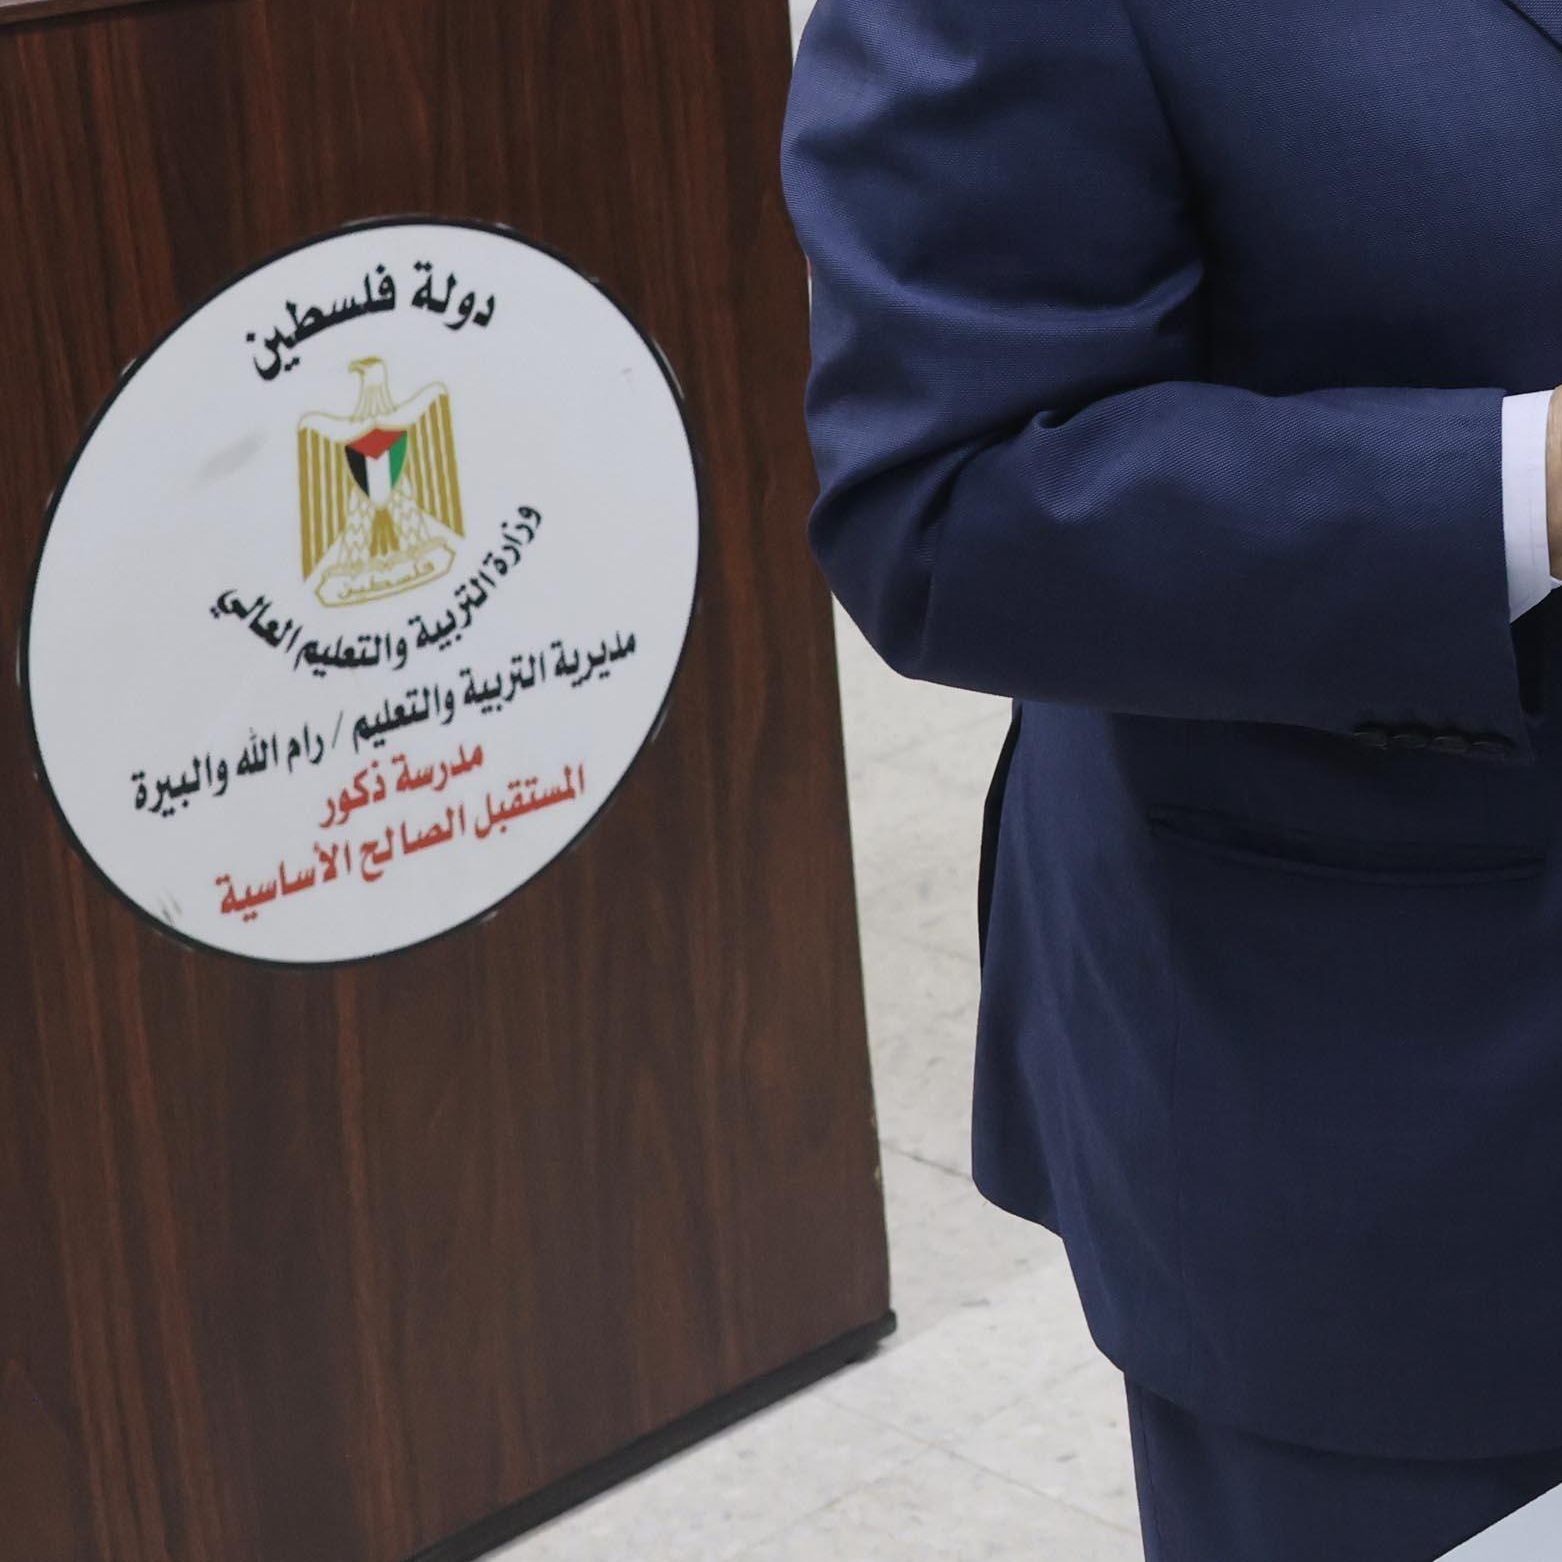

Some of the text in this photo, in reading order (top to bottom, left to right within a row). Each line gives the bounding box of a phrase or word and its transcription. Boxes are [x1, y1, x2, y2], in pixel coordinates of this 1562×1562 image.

[246, 260, 495, 381] دولة فلسطين
[210, 505, 541, 678] وزارة التربية والتعليم العالي
[338, 560, 436, 600] فلسطين
[131, 632, 637, 818] مديرية التربية والتعليم / رام الله والبيرة
[319, 744, 484, 828] مدرسة ذكور
[215, 765, 586, 922] المستقبل الصالح الأساسية
